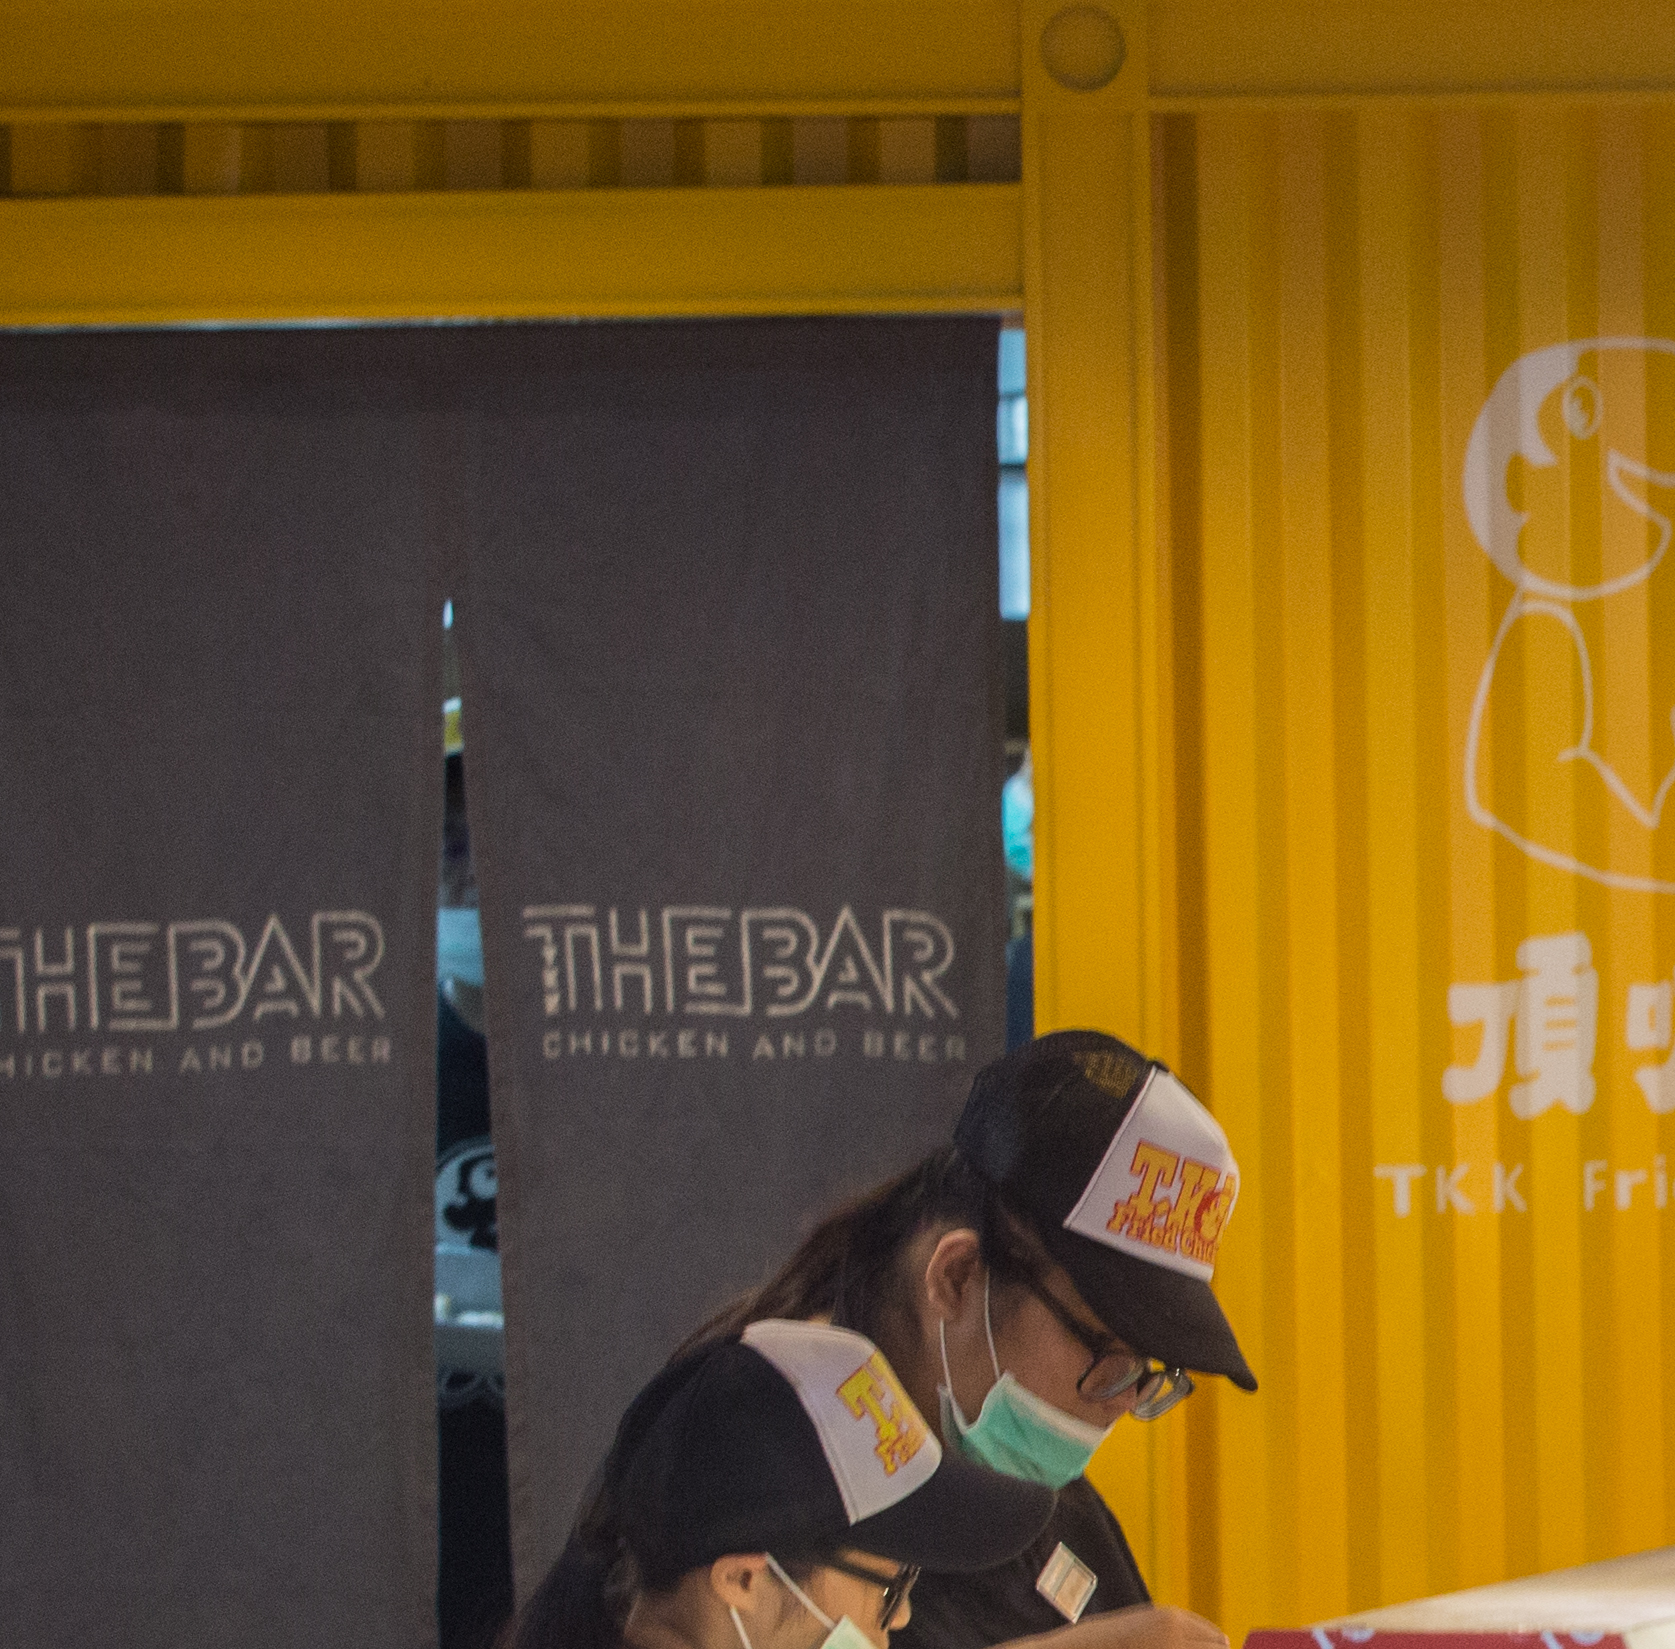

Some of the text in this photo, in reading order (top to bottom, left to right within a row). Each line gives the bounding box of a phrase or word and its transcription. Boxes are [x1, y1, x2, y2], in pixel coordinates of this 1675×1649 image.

[0, 1034, 392, 1081] HICKEN AND BEER
[542, 1028, 969, 1063] CHICKEN AND BEER
[1374, 1160, 1528, 1218] TKK
